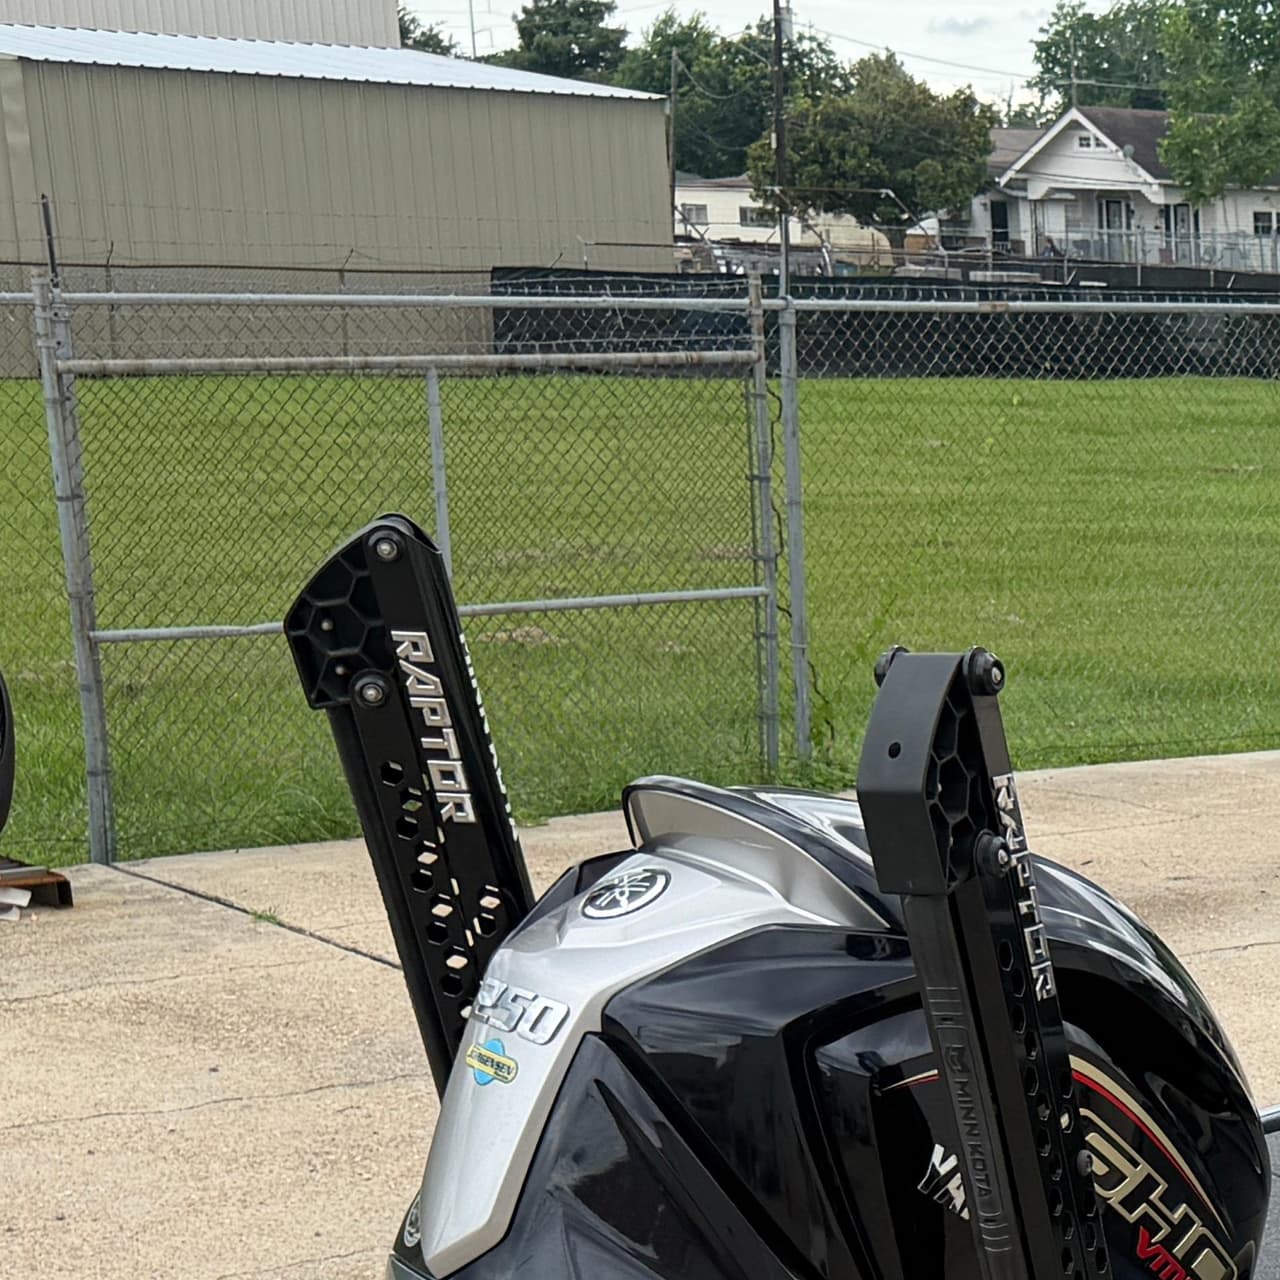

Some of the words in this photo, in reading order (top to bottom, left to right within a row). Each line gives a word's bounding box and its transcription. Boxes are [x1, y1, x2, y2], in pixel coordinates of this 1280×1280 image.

[391, 630, 476, 823] RAPTOR
[992, 772, 1058, 1002] RAPTOR
[474, 975, 570, 1045] 250
